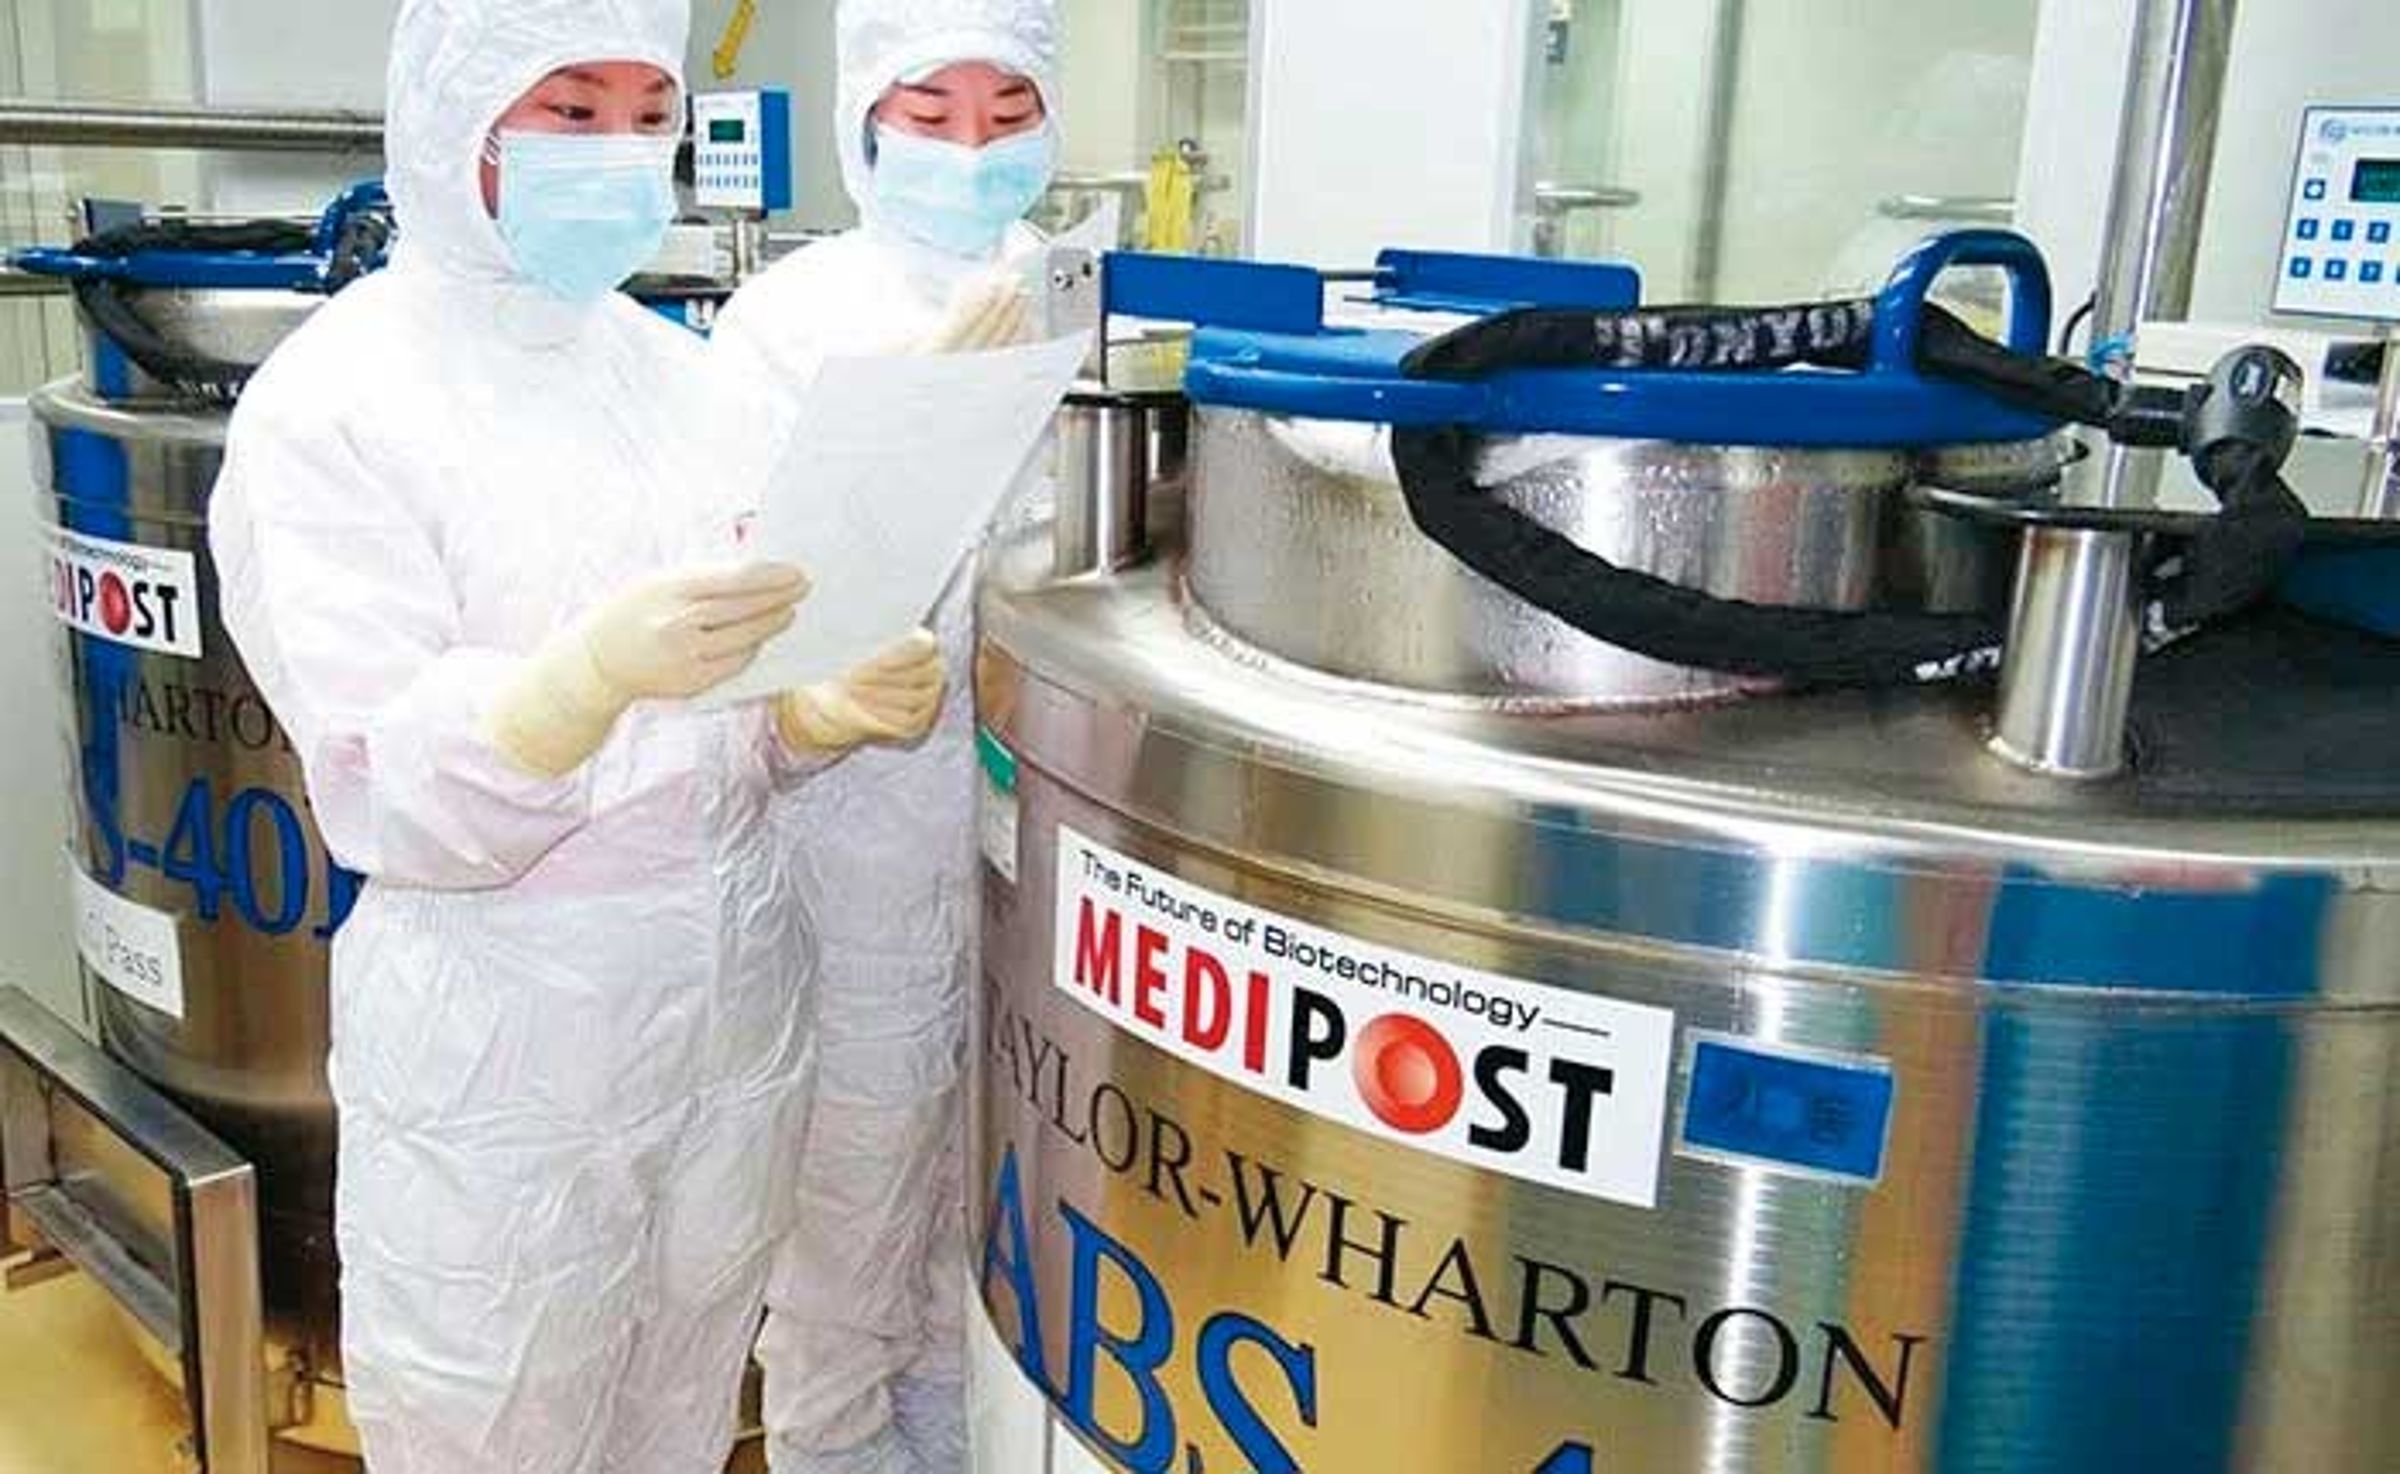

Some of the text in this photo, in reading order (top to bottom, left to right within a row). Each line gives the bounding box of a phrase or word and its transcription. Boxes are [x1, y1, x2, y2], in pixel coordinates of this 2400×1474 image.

[1074, 895, 1613, 1174] MEDIPOST
[1081, 849, 1541, 1031] The Future of Biotechnology
